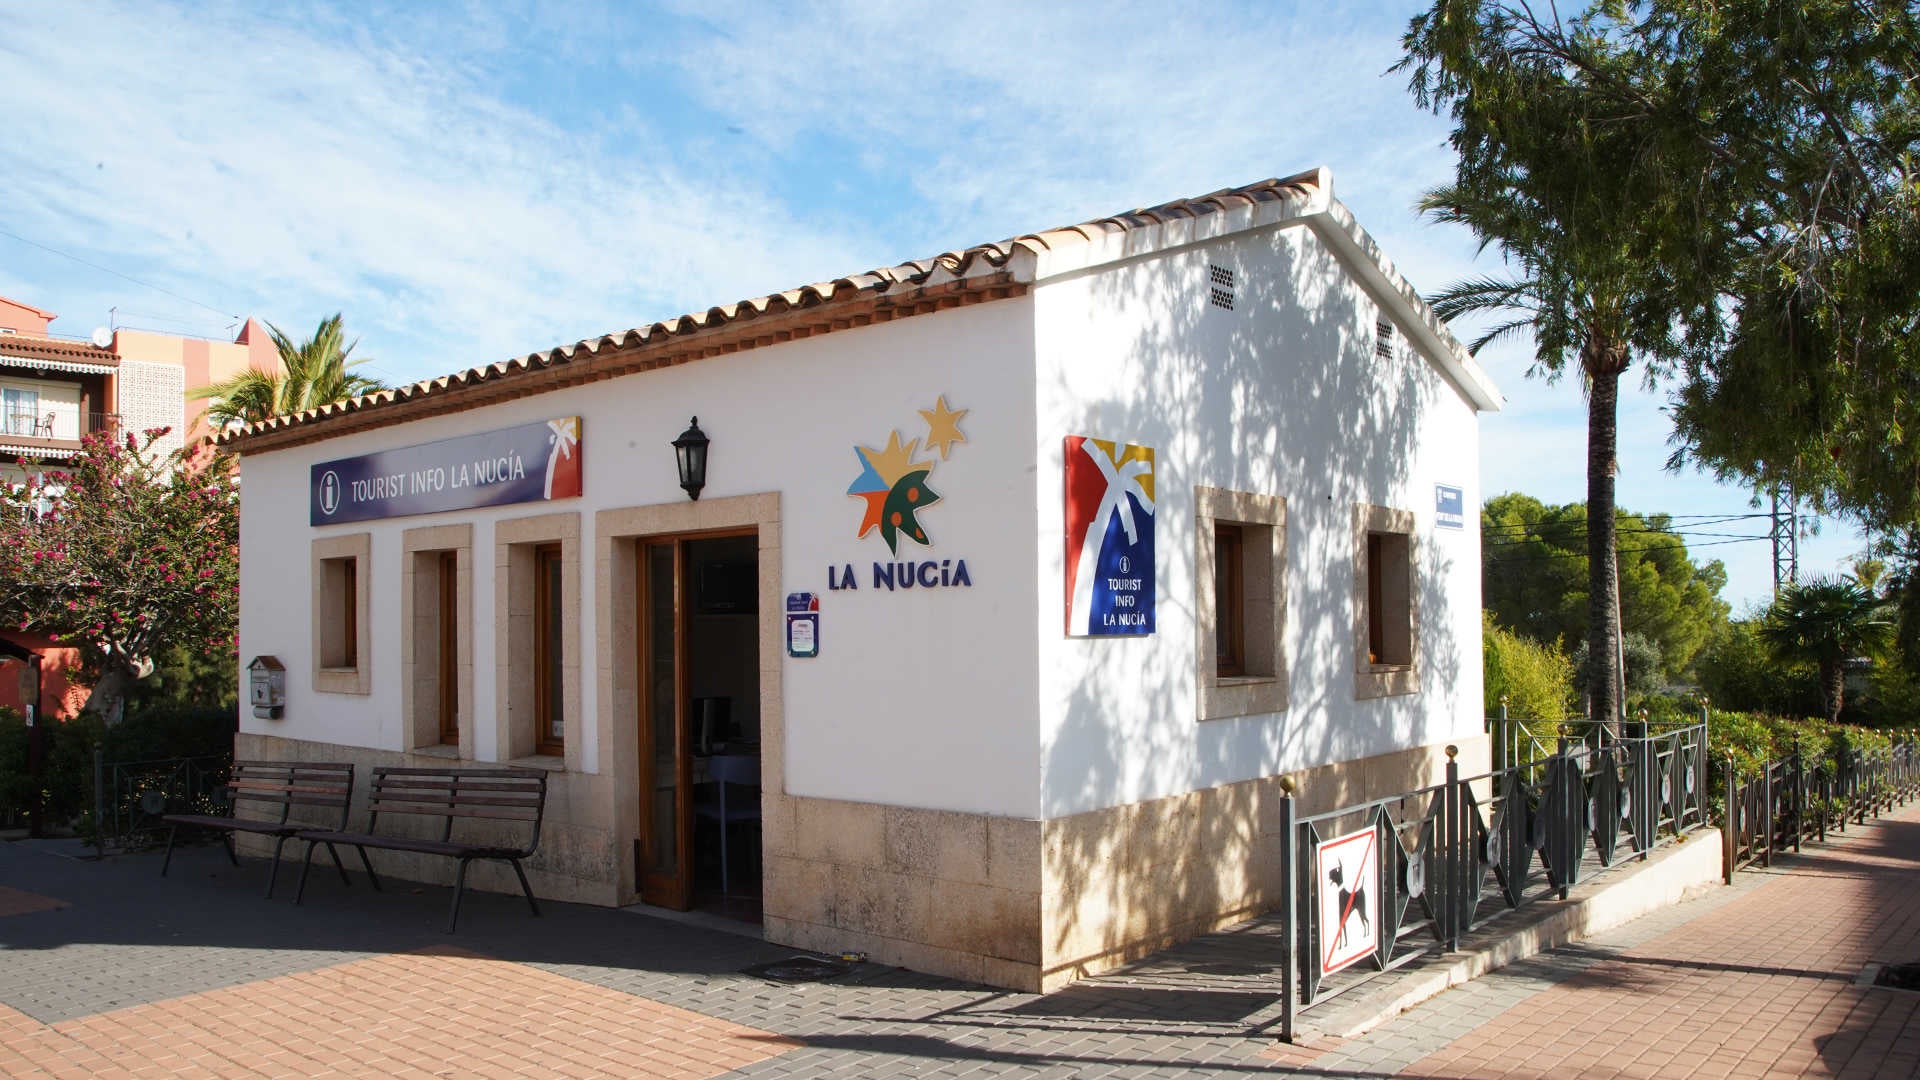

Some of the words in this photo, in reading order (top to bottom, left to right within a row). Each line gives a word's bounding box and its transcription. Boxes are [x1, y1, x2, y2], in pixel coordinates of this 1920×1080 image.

[352, 474, 406, 503] TOURIST
[411, 467, 445, 495] INFO
[451, 463, 470, 489] LA
[474, 449, 525, 485] NUCÍA
[828, 563, 858, 591] LA
[1107, 578, 1142, 591] TOURIST
[1115, 595, 1135, 607] INFO
[1103, 613, 1116, 626] LA
[1119, 611, 1146, 626] NUCÍA
